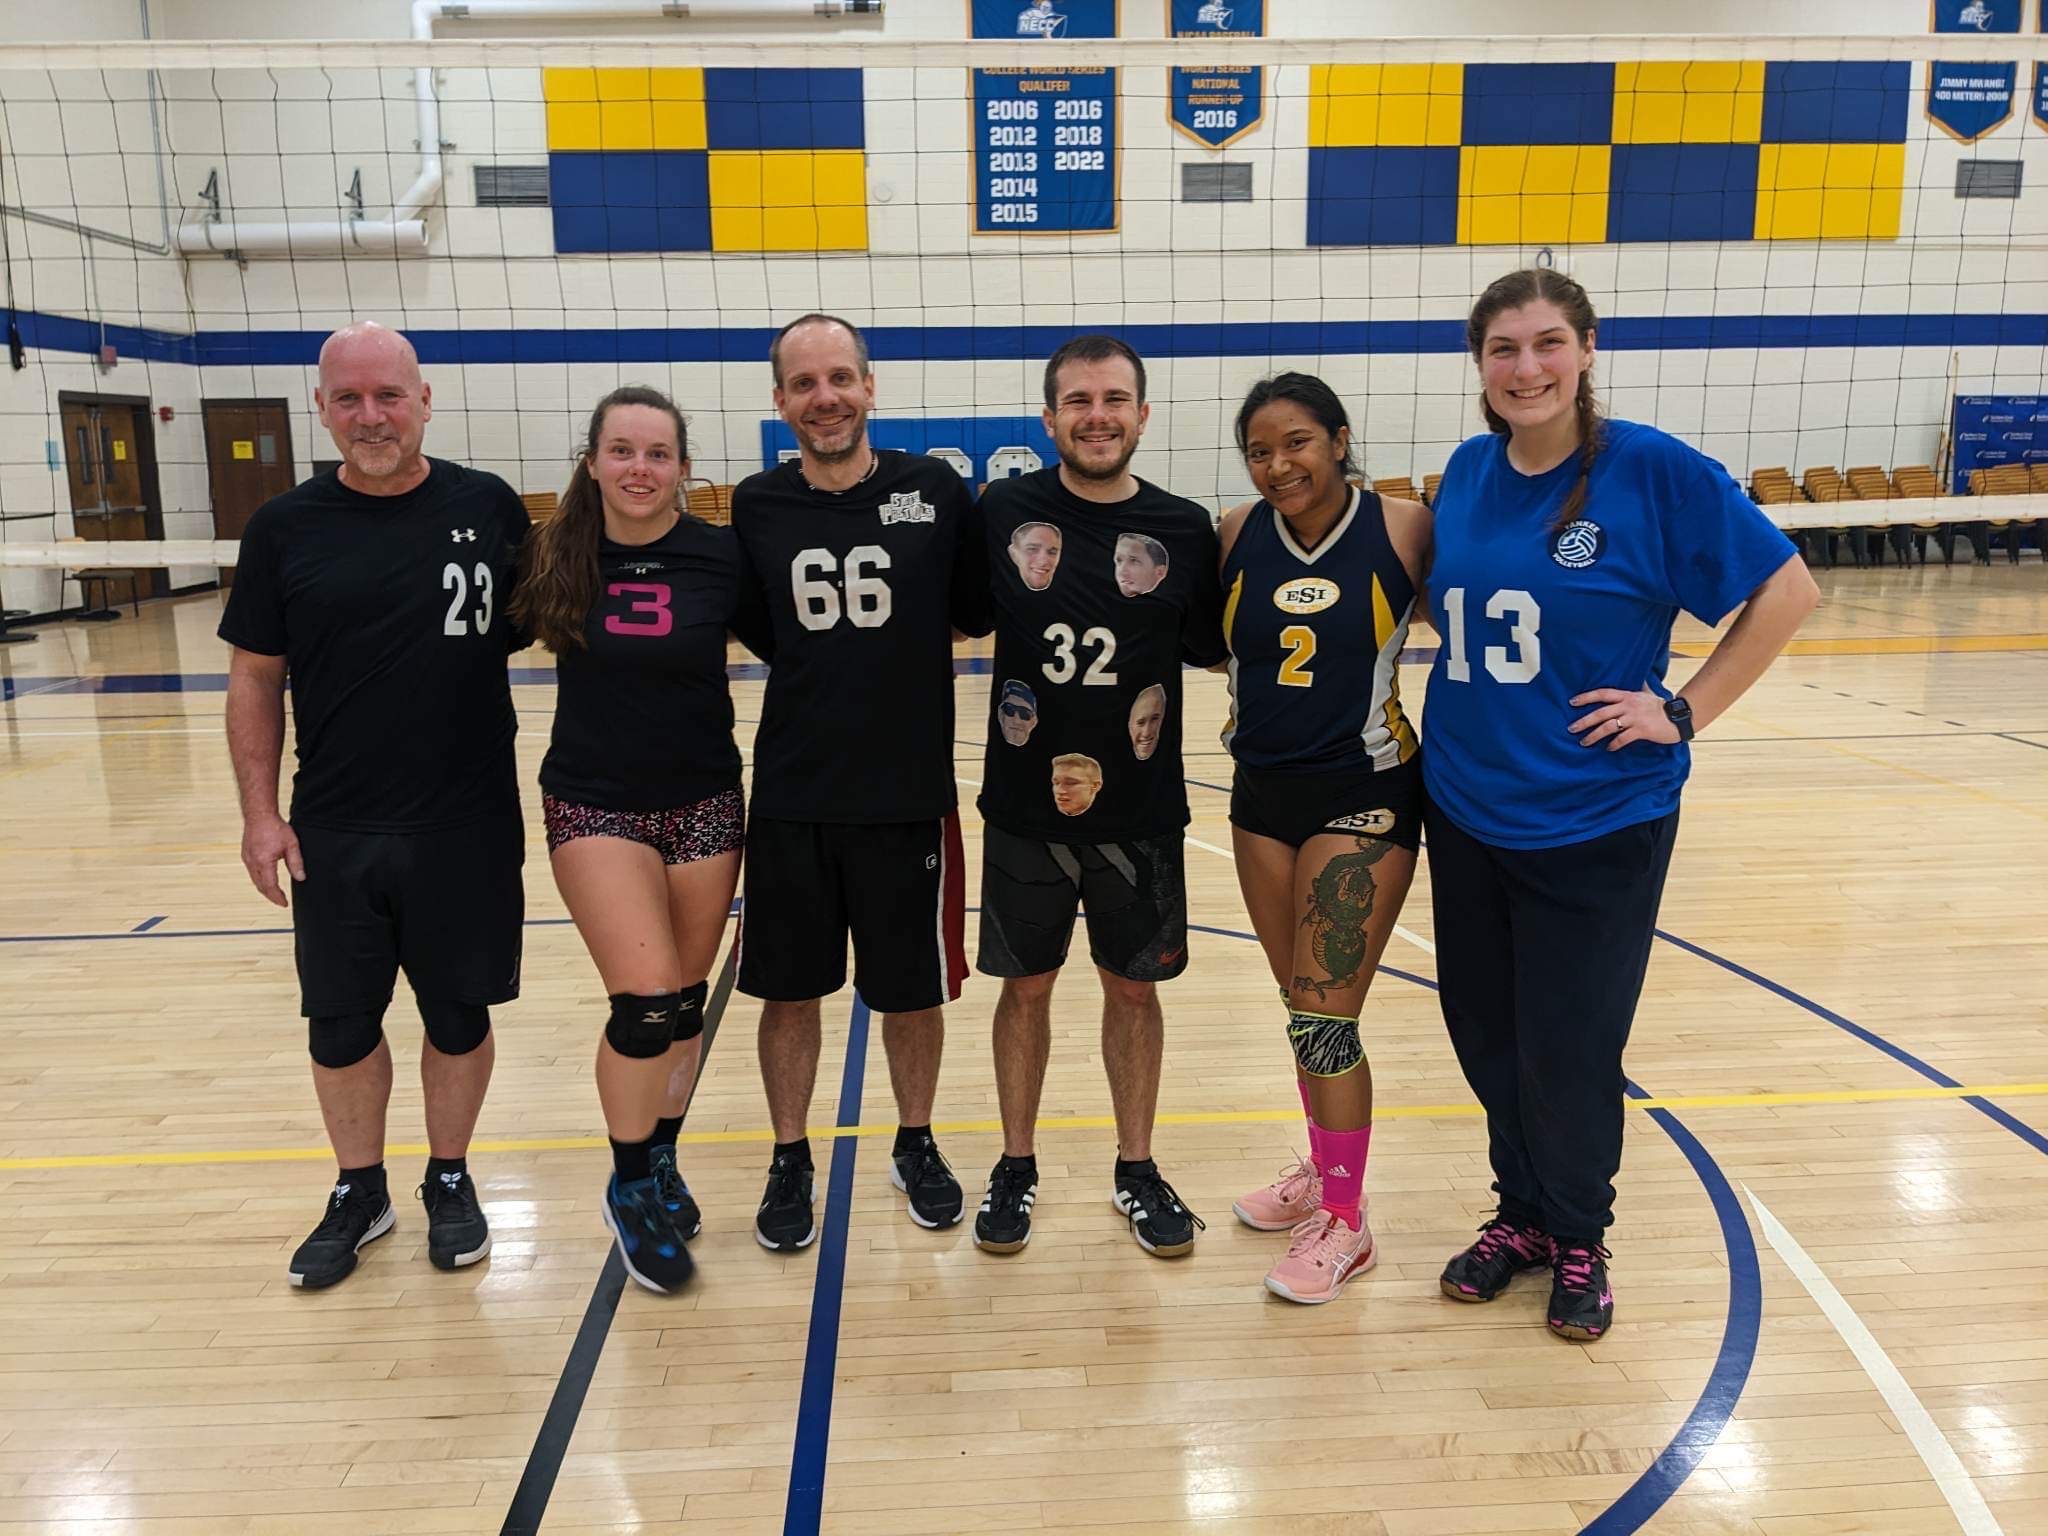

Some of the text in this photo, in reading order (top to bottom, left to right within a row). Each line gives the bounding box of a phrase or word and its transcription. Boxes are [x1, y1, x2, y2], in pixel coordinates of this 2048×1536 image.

[1192, 79, 1241, 89] NATIONAL
[987, 100, 1103, 120] 2006 2016
[1193, 110, 1238, 128] 2016
[989, 126, 1103, 146] 2012 2018
[990, 151, 1105, 172] 2013 2022
[990, 178, 1038, 197] 2014
[991, 203, 1038, 222] 2015
[791, 545, 892, 631] 66
[1285, 587, 1327, 604] ESI
[443, 562, 493, 635] 23
[605, 583, 673, 636] 3
[1443, 587, 1541, 683] 13
[1042, 623, 1118, 686] 32
[1277, 625, 1317, 687] 2
